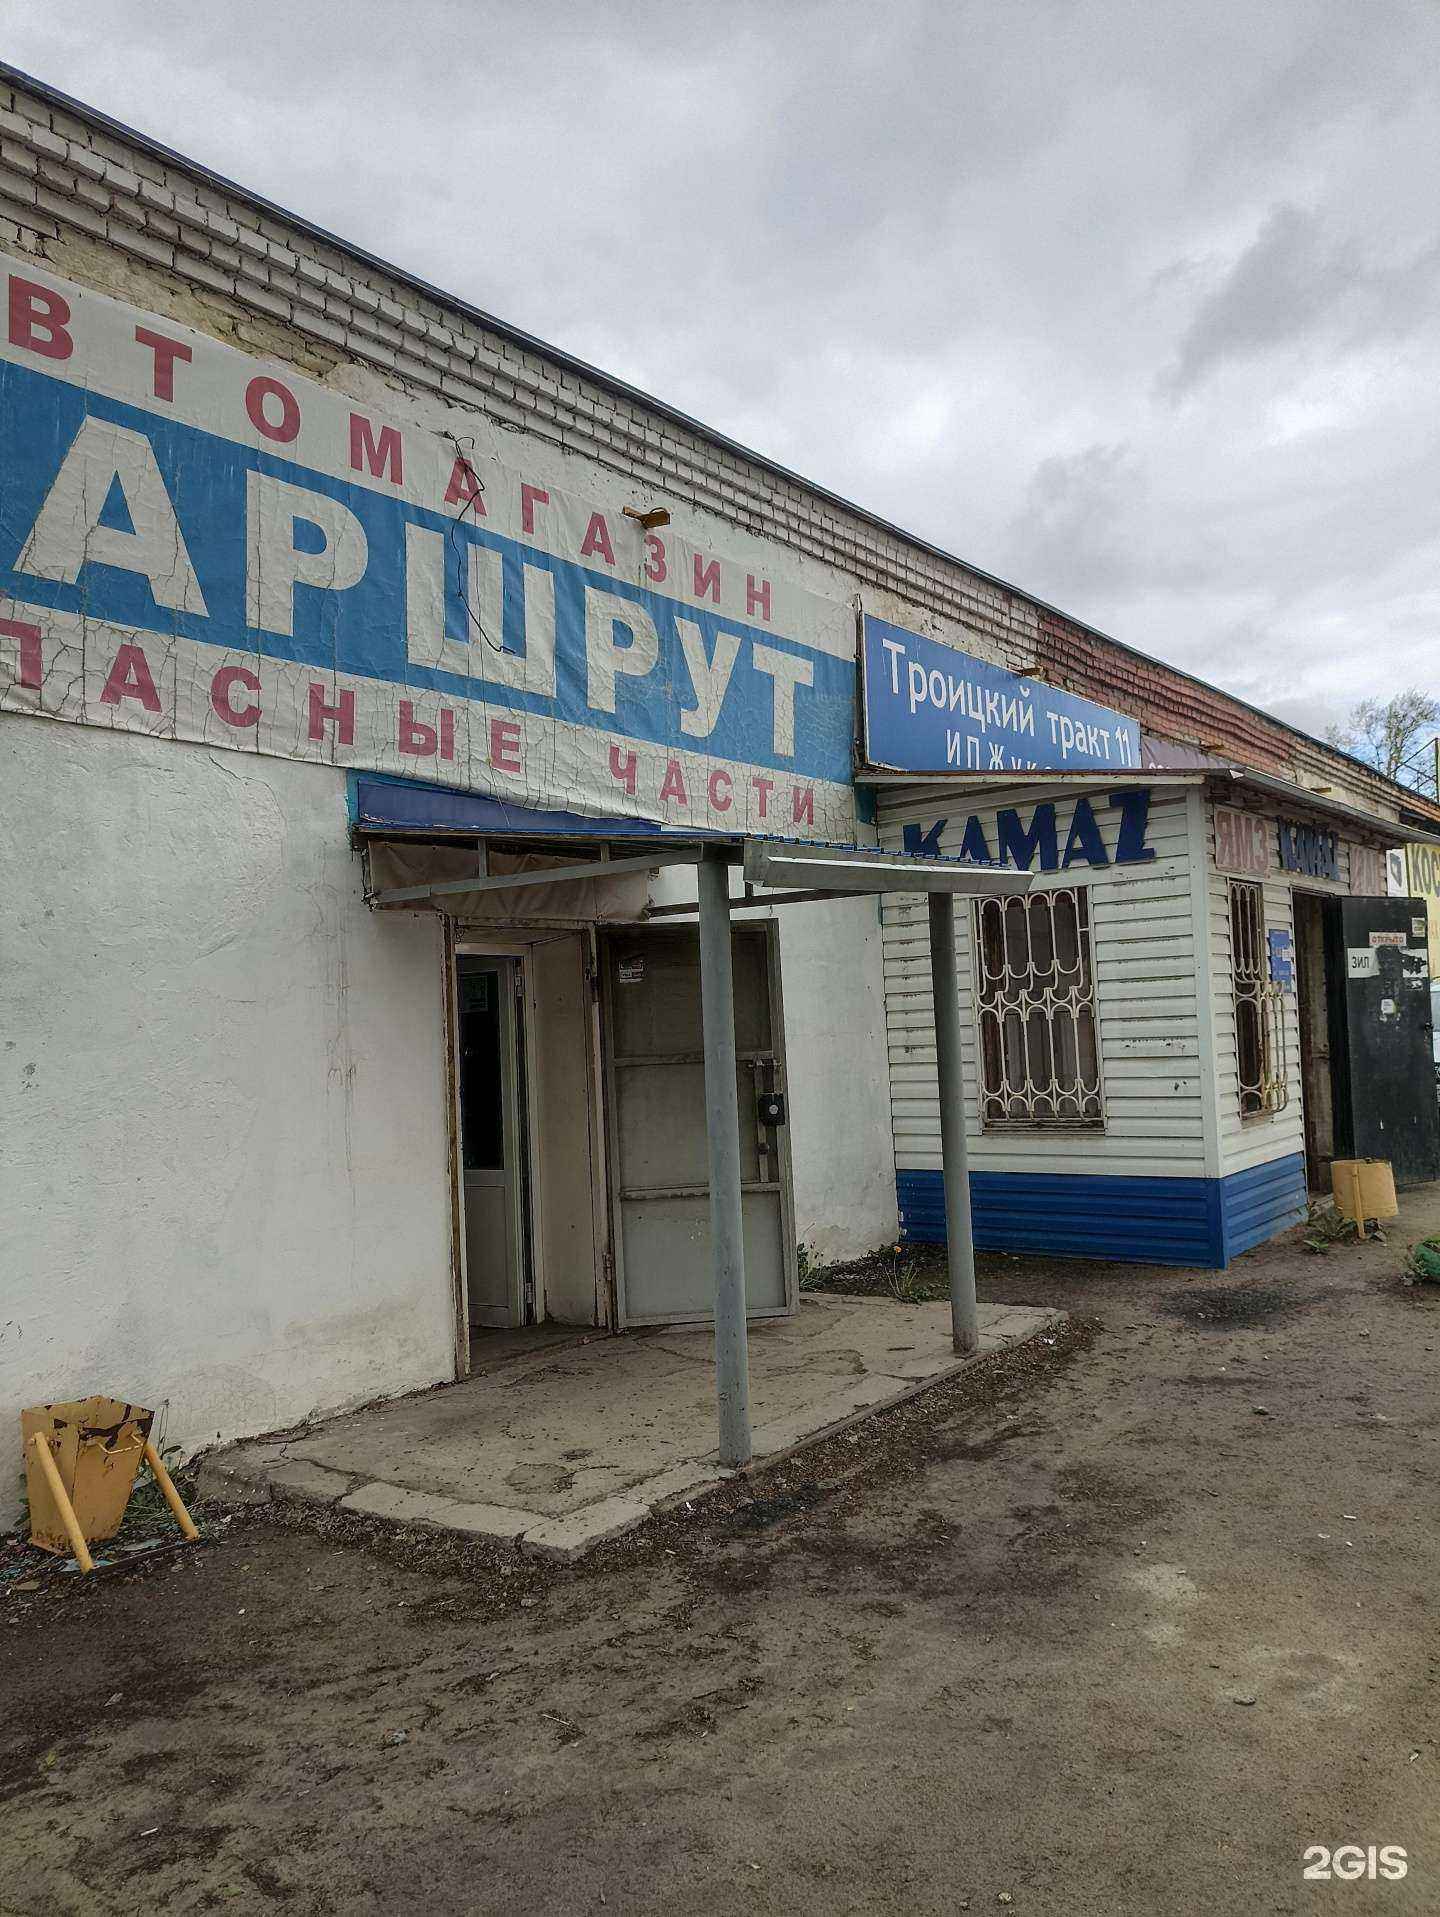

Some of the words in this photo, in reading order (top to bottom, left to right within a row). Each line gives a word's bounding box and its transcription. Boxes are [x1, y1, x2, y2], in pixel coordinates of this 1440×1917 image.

[11, 414, 815, 758] АРШРУТ
[882, 638, 1034, 737] Троицкий
[1045, 709, 1111, 760] тракт
[1115, 725, 1132, 767] 11
[608, 744, 815, 827] ЧАСТИ
[1351, 956, 1370, 969] ЗИЛ
